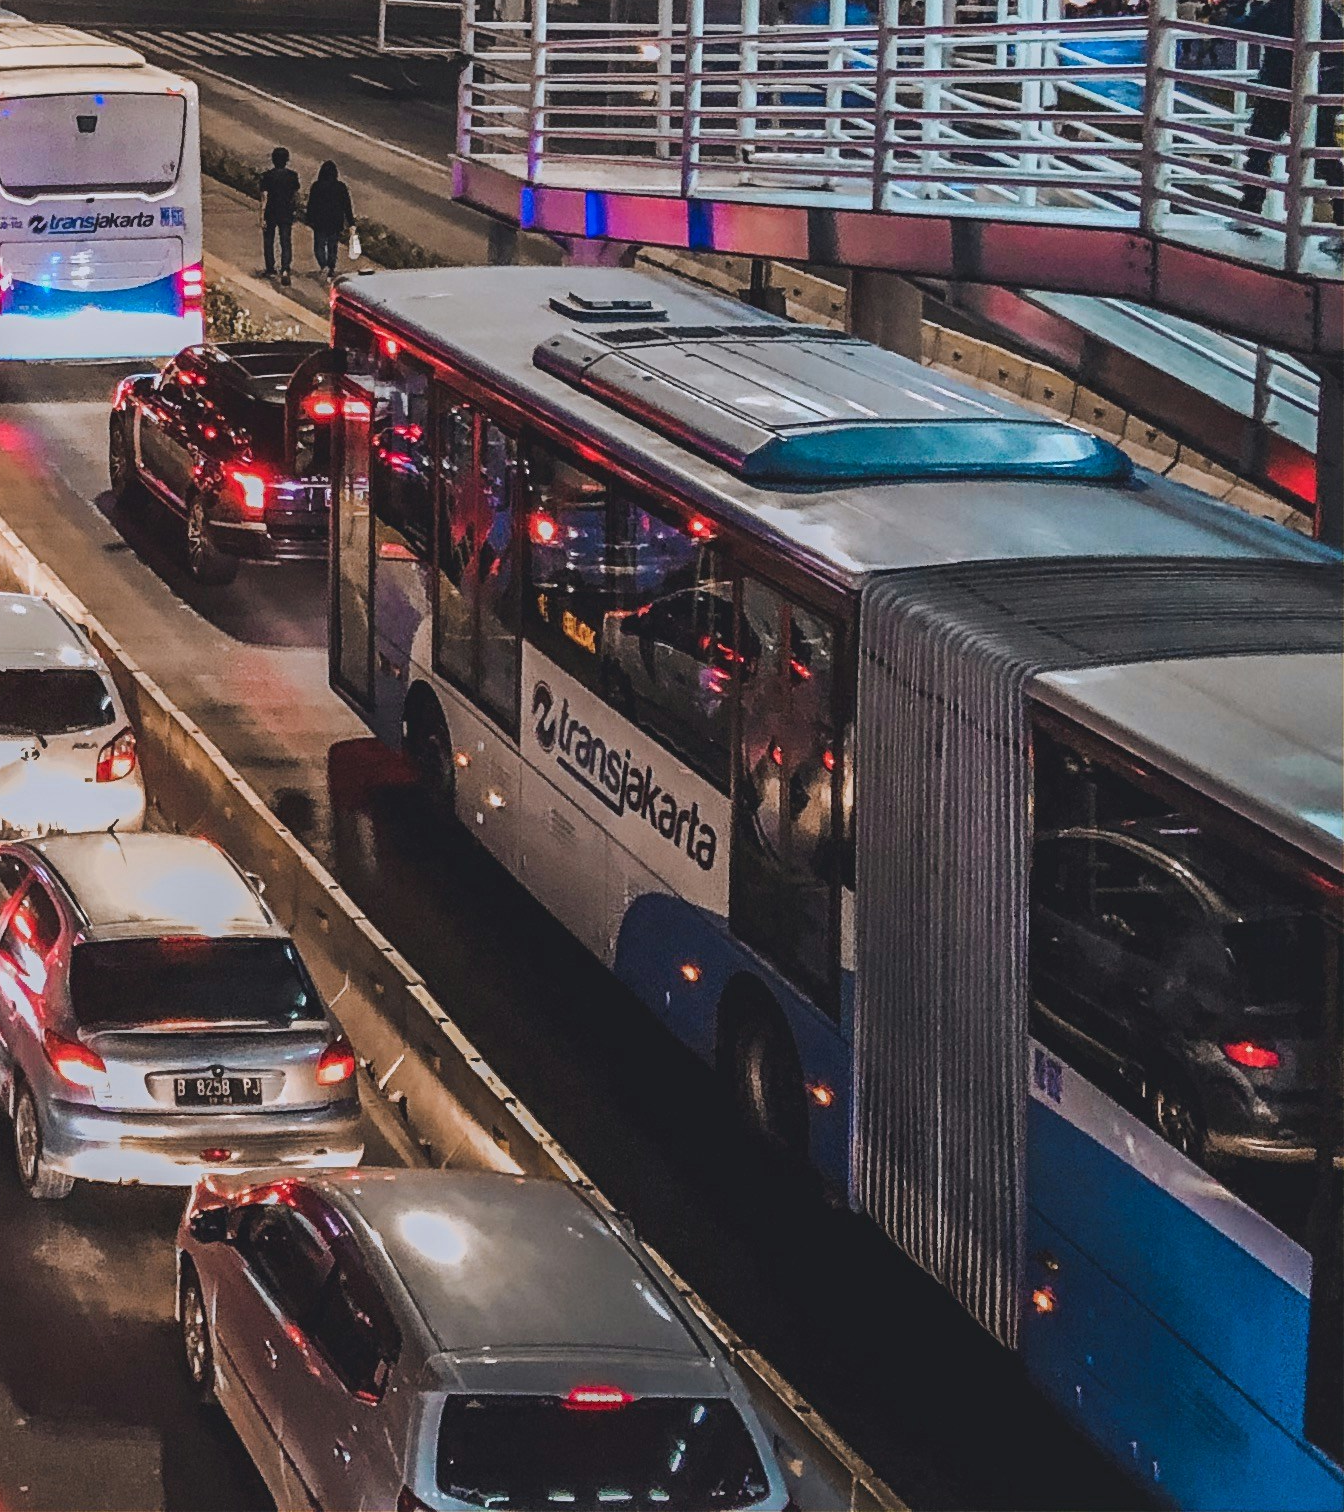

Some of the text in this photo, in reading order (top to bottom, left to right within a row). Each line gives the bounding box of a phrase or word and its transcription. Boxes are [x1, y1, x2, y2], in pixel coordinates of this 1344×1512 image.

[49, 211, 155, 234] transjakarta
[557, 698, 717, 871] transjakarta
[177, 1078, 261, 1097] B 8258 PJ
